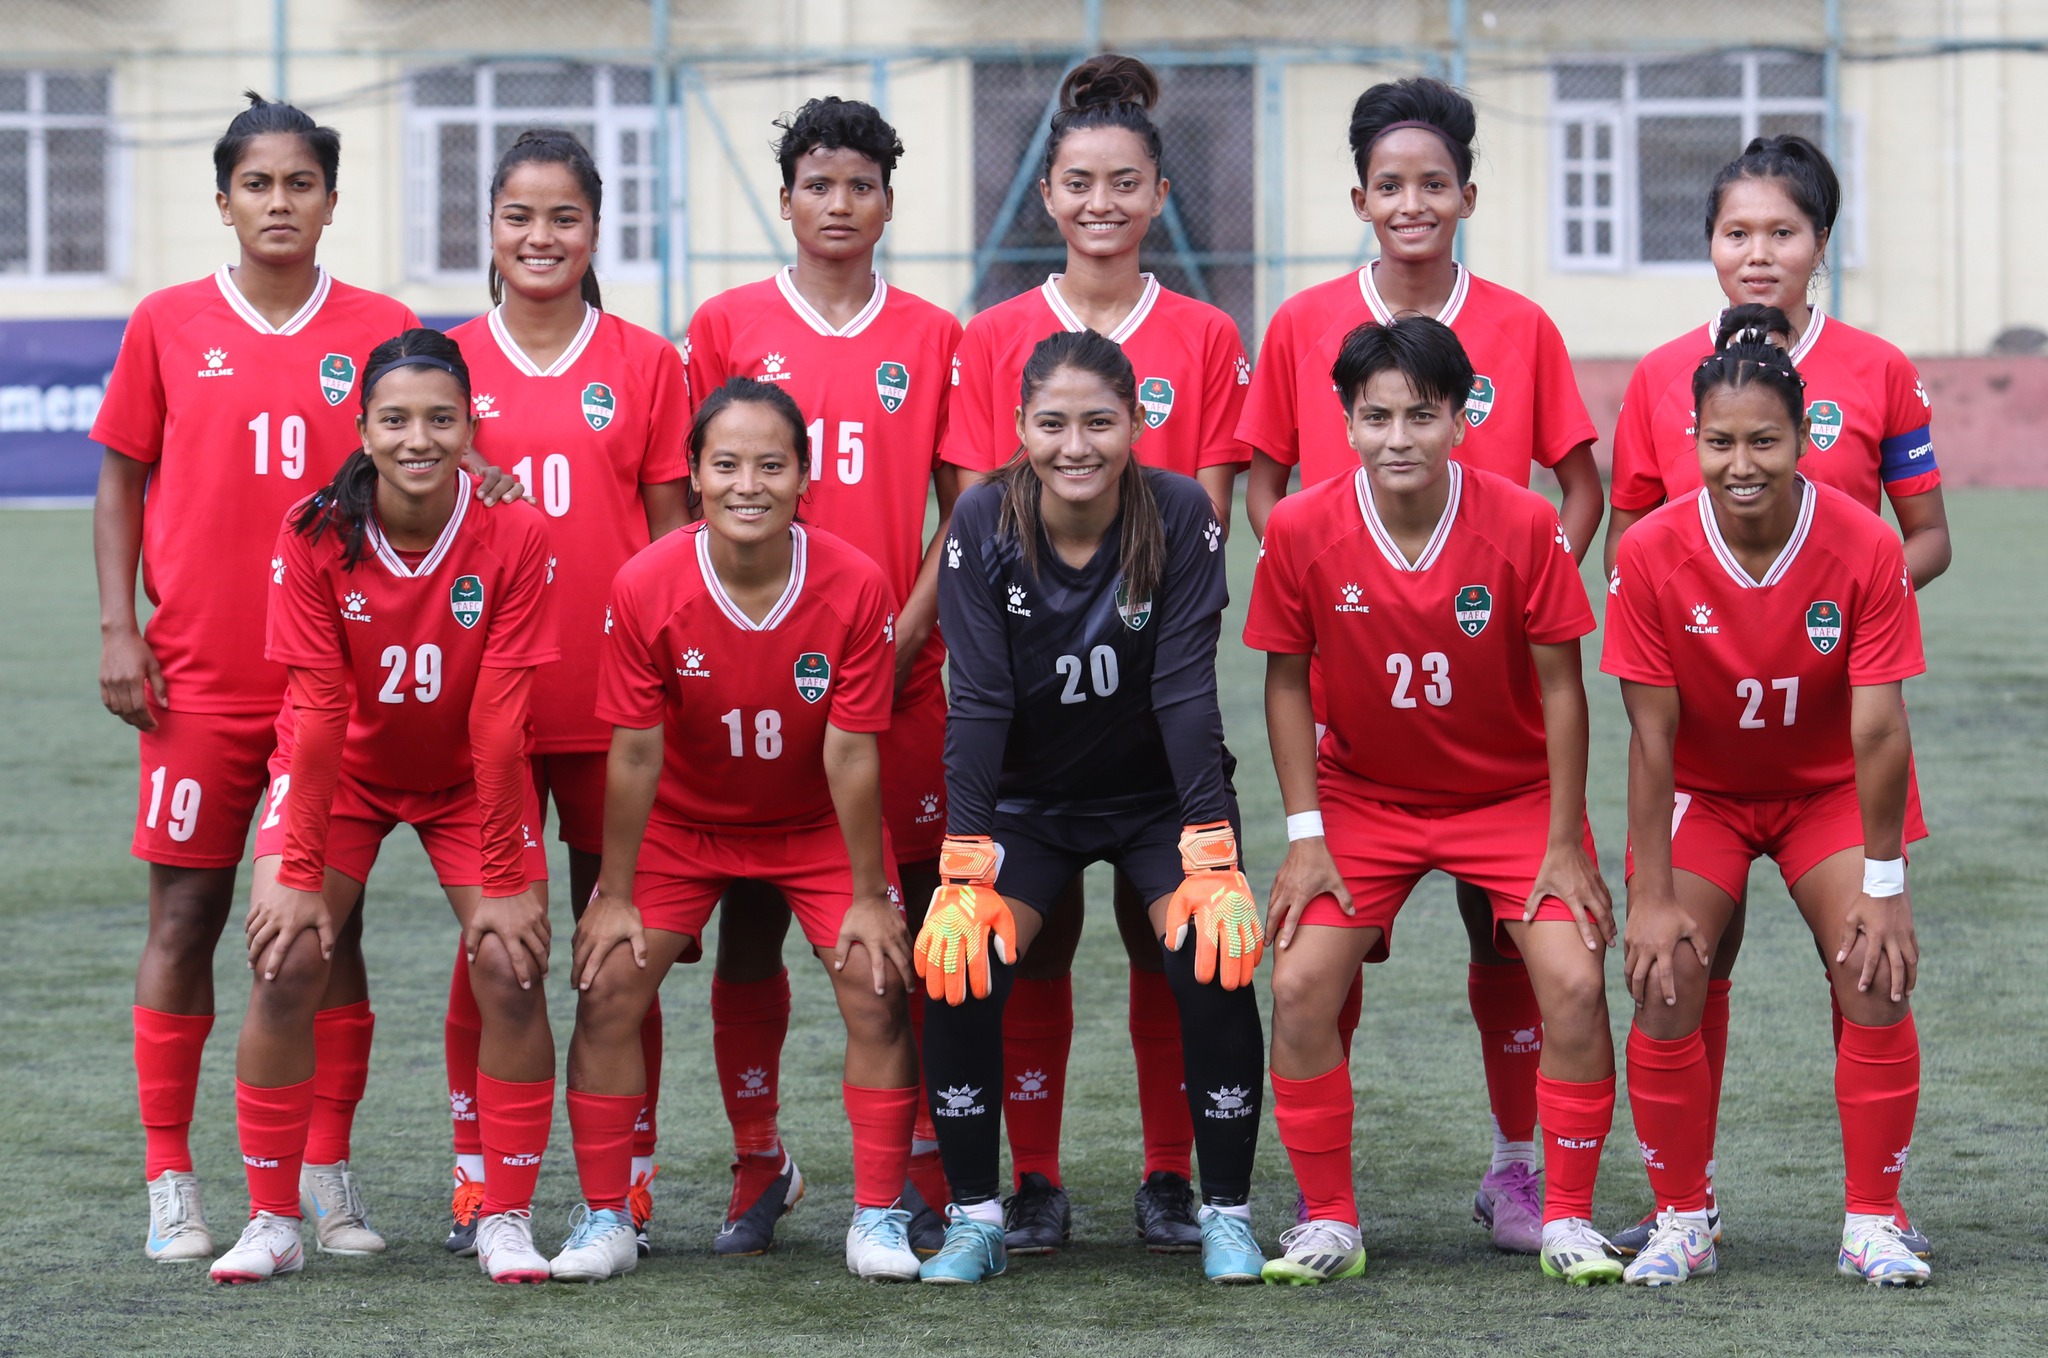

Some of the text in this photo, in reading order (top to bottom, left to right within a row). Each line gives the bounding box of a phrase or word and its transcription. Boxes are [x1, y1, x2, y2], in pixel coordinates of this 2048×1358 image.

[197, 368, 234, 378] KELME
[757, 372, 791, 383] KELME
[325, 377, 348, 392] TAFC
[882, 386, 903, 398] TAFC
[588, 405, 611, 417] TAFC
[1145, 401, 1167, 413] TAFC
[479, 410, 501, 419] LME
[1812, 425, 1836, 435] TAFC
[248, 412, 306, 480] 19
[807, 418, 864, 485] 15
[512, 453, 571, 518] 10
[456, 602, 480, 611] TAFC
[1007, 604, 1031, 617] ELME
[1335, 604, 1370, 614] KELME
[1461, 610, 1486, 620] TAFC
[1684, 624, 1719, 634] KELME
[1812, 627, 1837, 637] TAFC
[378, 643, 442, 704] 29
[676, 667, 711, 678] KELME
[1056, 644, 1119, 705] 20
[800, 677, 825, 688] TAFC
[1386, 651, 1453, 709] 23
[1736, 676, 1799, 730] 27
[721, 708, 783, 760] 18
[146, 765, 202, 842] 19
[261, 773, 291, 831] 2
[737, 1086, 770, 1098] KELME
[1010, 1090, 1049, 1101] KELME
[451, 1111, 476, 1121] ELME
[936, 1104, 985, 1118] KELME
[1205, 1104, 1253, 1119] KELME
[1557, 1137, 1597, 1149] KELME
[502, 1155, 541, 1167] KELME
